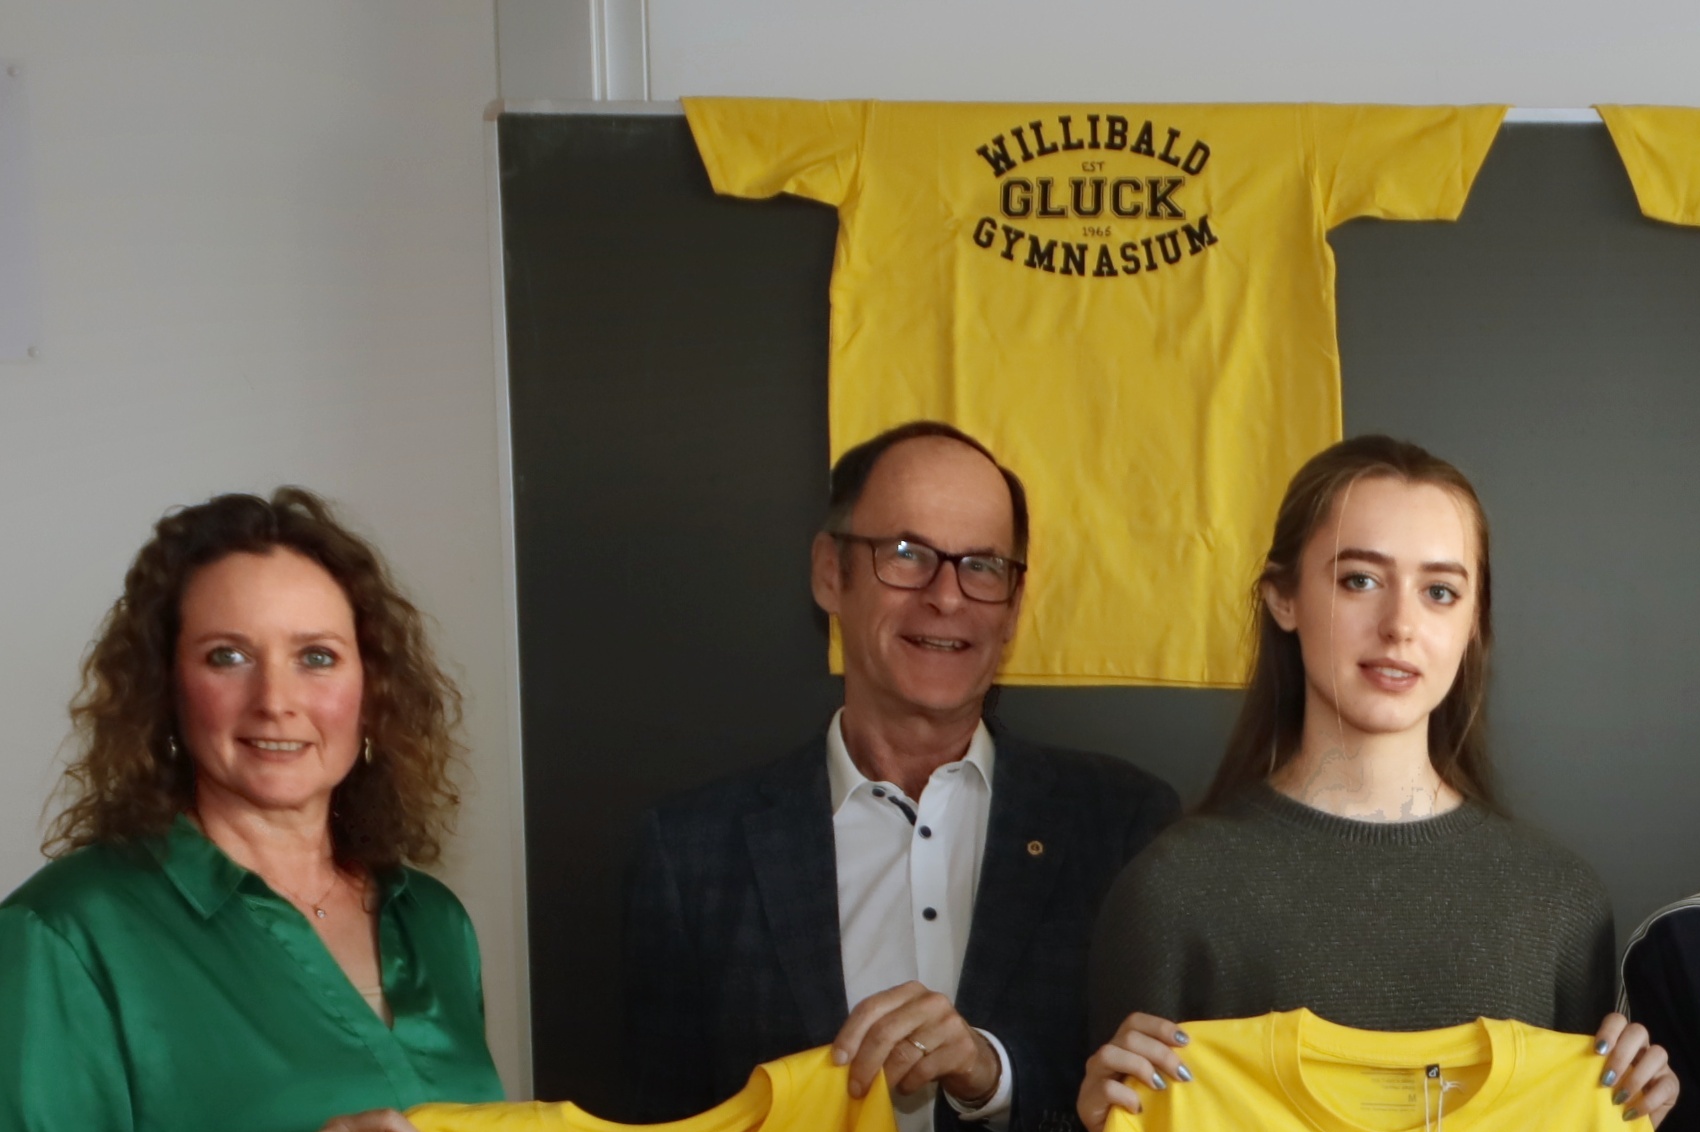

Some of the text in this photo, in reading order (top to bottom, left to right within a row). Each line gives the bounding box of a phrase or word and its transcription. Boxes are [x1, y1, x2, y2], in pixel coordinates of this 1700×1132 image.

[976, 114, 1211, 178] WILLIBALD
[1082, 161, 1105, 172] EST
[1000, 176, 1185, 220] GLUCK
[972, 215, 1218, 277] GYMNASIUM
